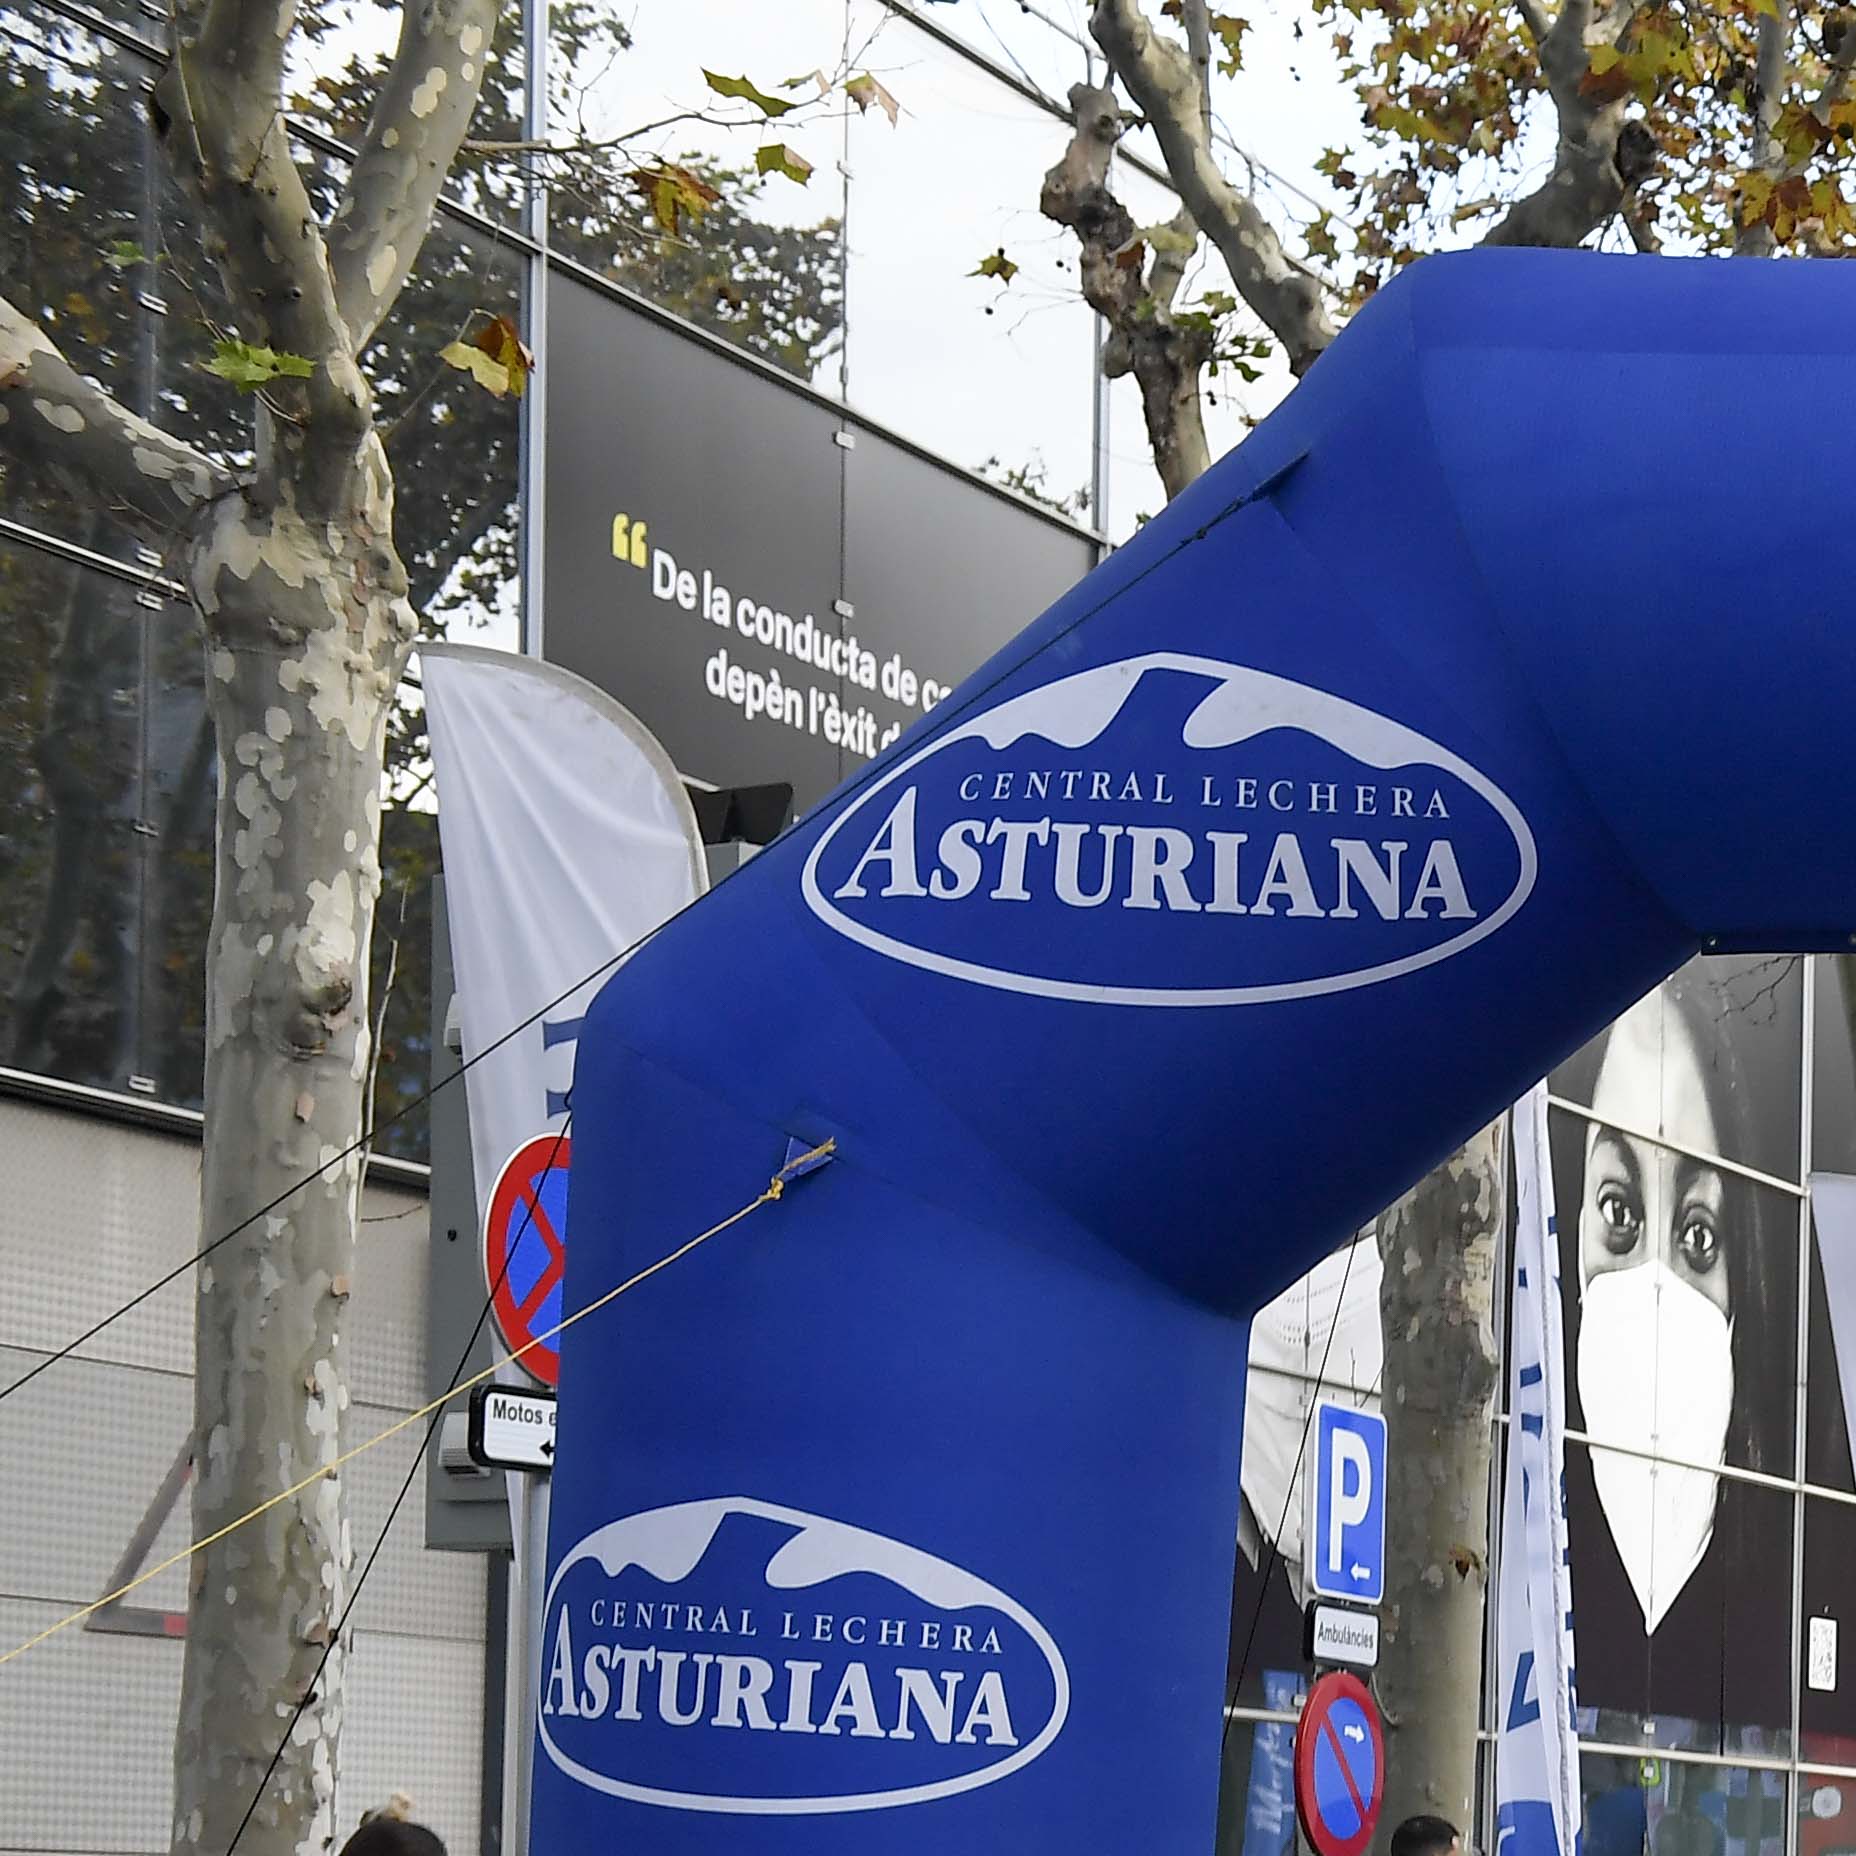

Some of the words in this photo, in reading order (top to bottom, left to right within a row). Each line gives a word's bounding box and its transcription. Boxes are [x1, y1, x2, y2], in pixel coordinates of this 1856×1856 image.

[703, 570, 731, 628] la
[737, 598, 876, 690] conducta
[881, 655, 918, 707] de
[706, 649, 803, 729] depèn
[959, 771, 1174, 805] CENTRAL
[1202, 776, 1451, 819] LECHERA
[833, 785, 1477, 920] ASTURIANA
[493, 1398, 543, 1425] Motos
[1328, 1427, 1372, 1572] P
[591, 1599, 758, 1637] CENTRAL
[783, 1612, 1003, 1655] LECHERA
[1317, 1623, 1374, 1649] Ambulàncies
[543, 1603, 1019, 1747] ASTURIANA
